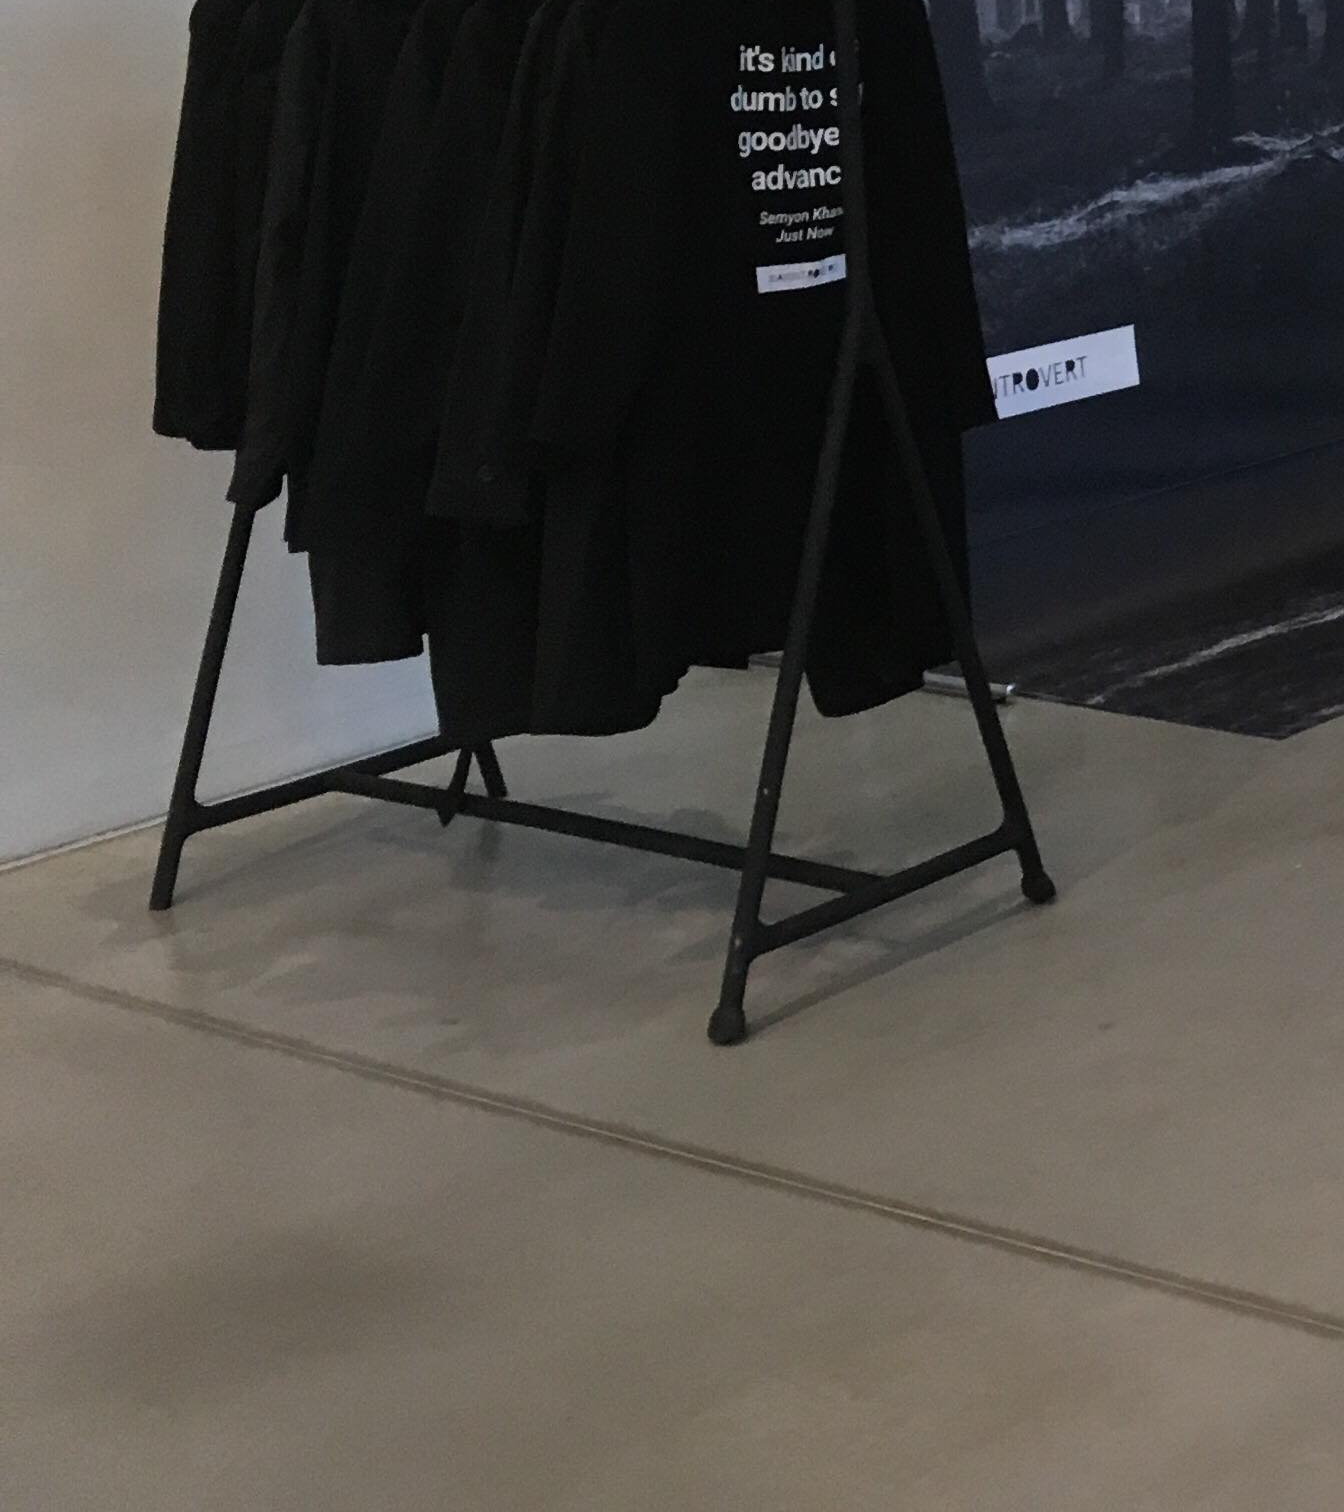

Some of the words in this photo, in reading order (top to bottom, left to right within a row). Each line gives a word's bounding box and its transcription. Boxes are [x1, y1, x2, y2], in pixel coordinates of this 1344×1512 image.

[739, 44, 775, 72] it's
[781, 43, 824, 72] kind
[730, 84, 796, 112] dumb
[800, 87, 824, 110] to
[738, 123, 841, 158] goodbye
[751, 164, 842, 191] advanc
[759, 211, 809, 227] Semyon
[776, 229, 803, 243] Just
[806, 226, 834, 240] Now
